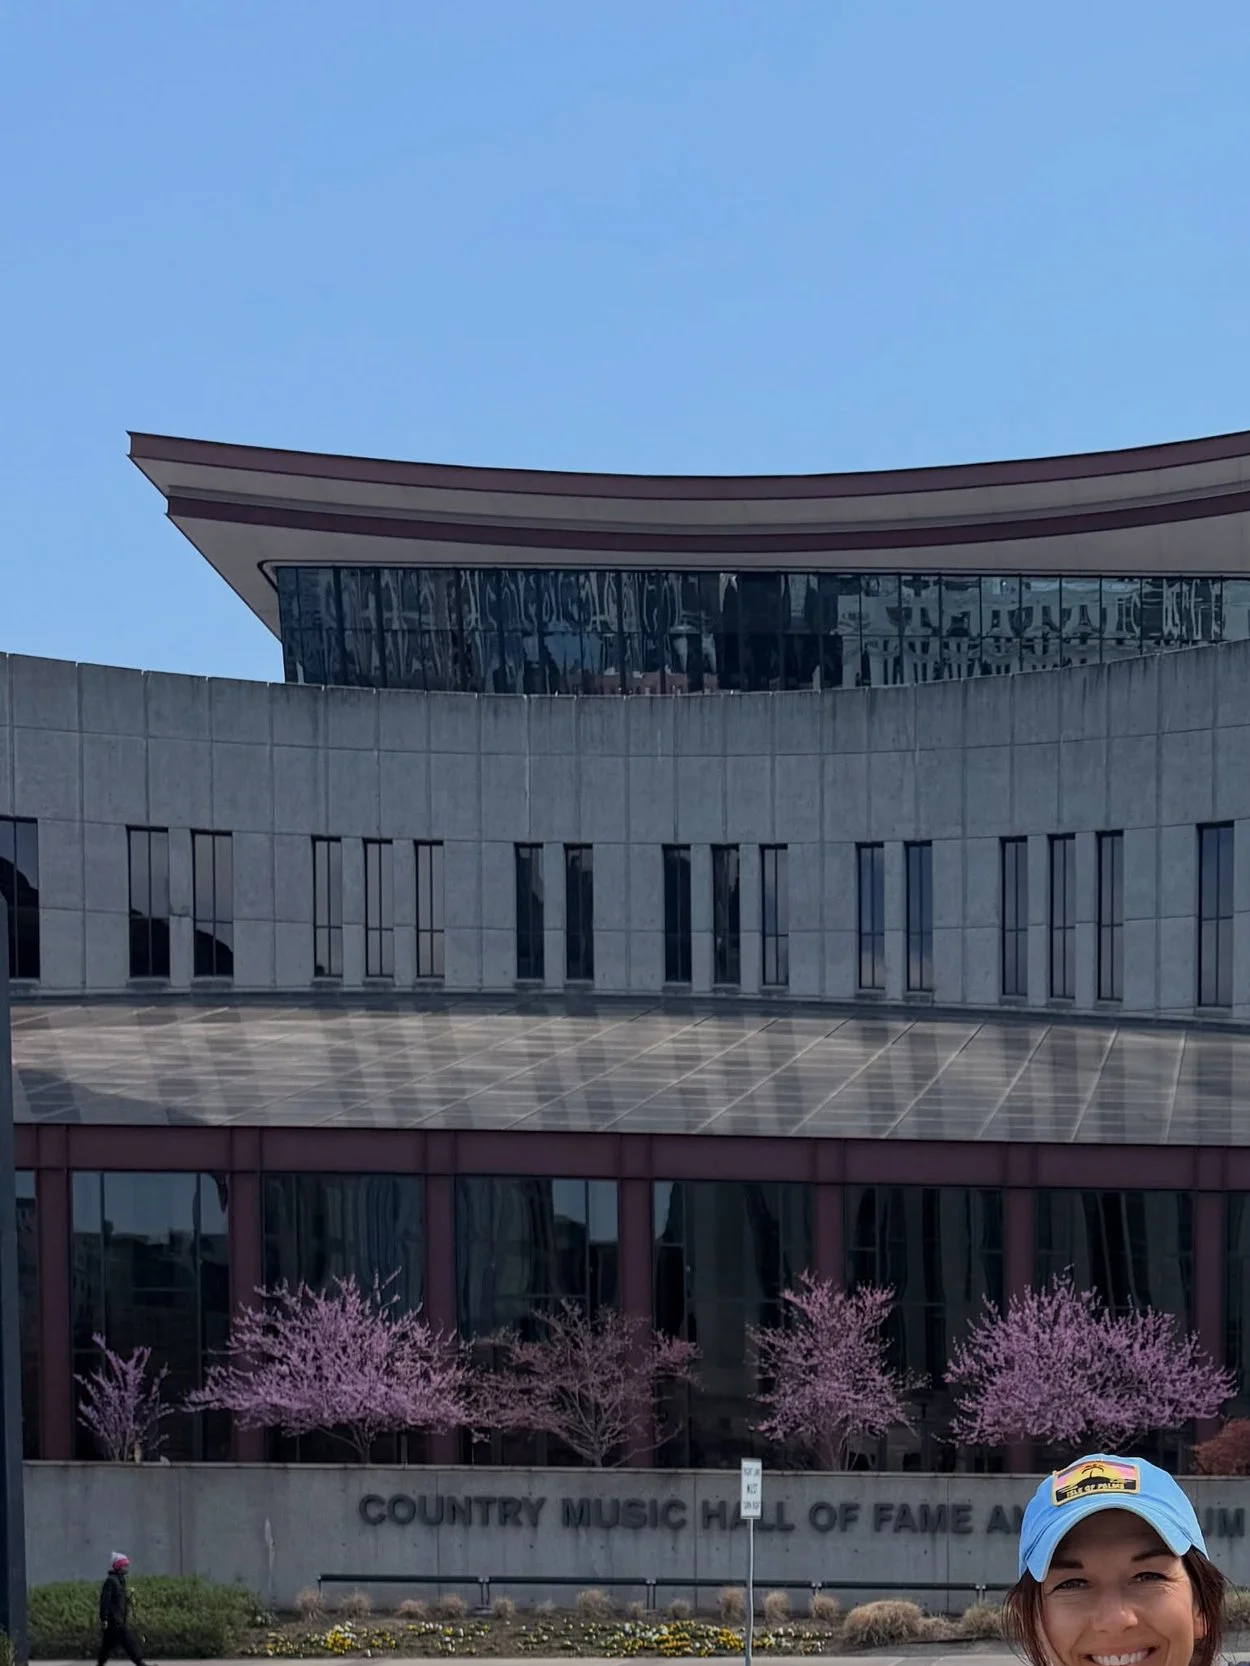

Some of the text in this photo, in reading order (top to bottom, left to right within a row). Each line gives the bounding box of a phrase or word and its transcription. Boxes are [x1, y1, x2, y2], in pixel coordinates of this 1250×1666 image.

[1066, 1487, 1083, 1499] ISLE
[358, 1494, 547, 1527] COUNTRY
[561, 1497, 688, 1530] MUSIC
[808, 1502, 860, 1533] OF
[873, 1503, 973, 1535] FAME
